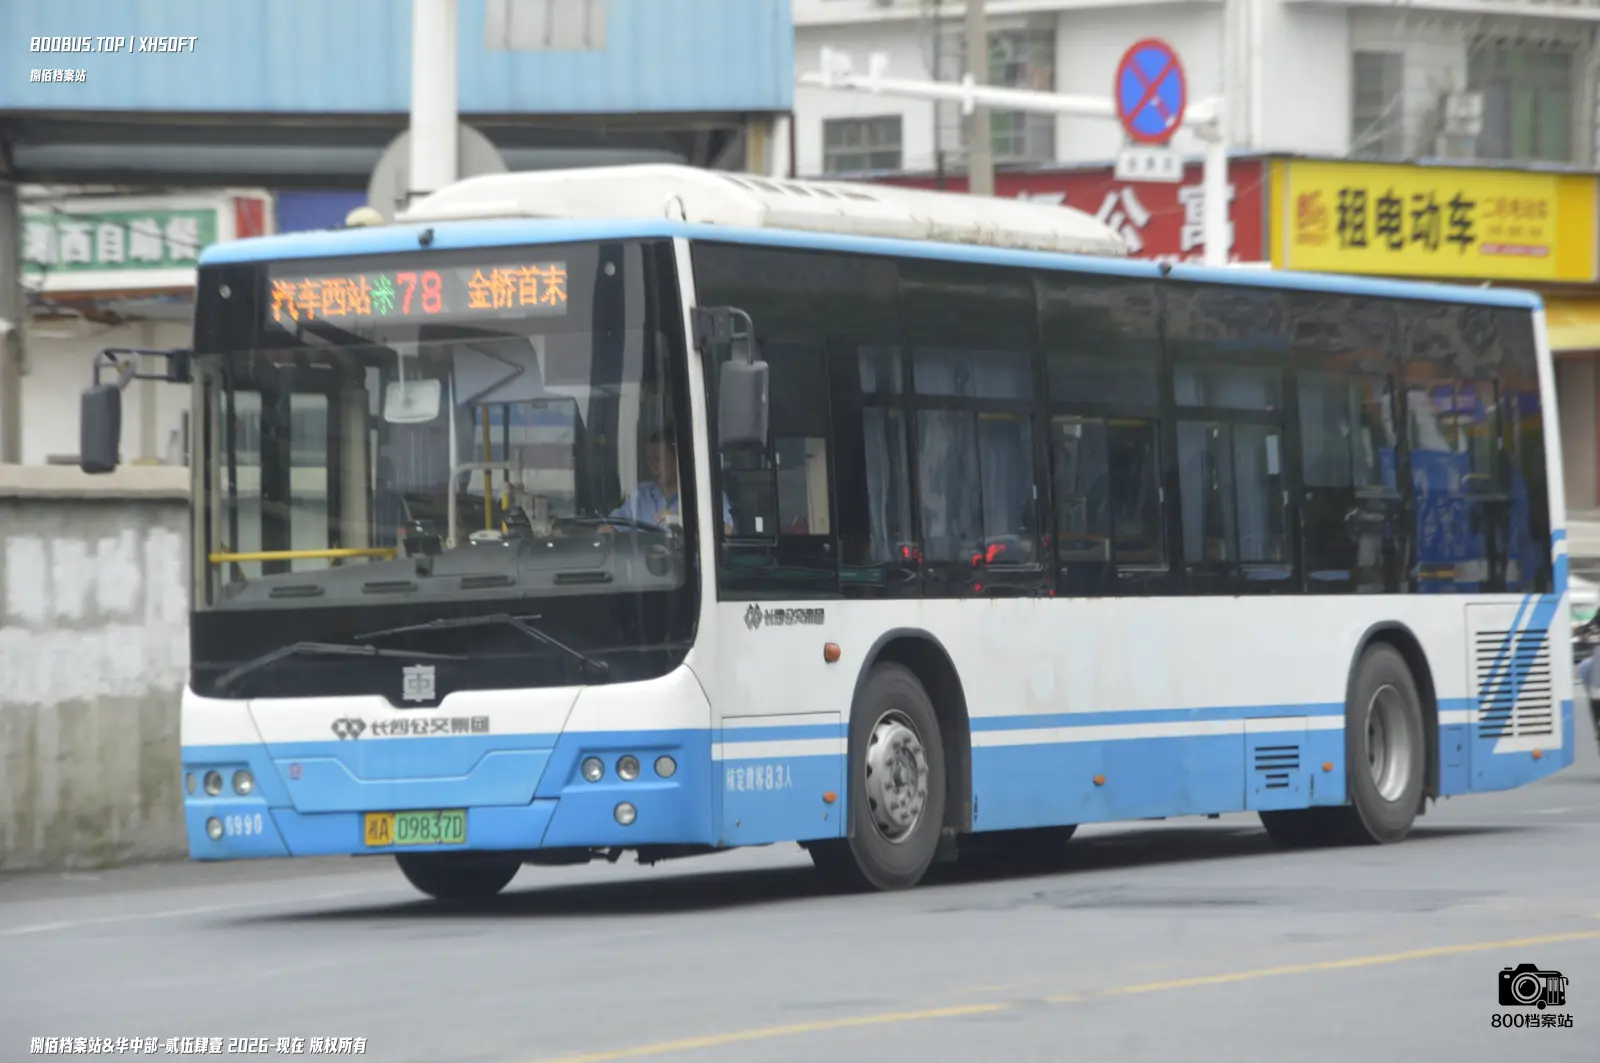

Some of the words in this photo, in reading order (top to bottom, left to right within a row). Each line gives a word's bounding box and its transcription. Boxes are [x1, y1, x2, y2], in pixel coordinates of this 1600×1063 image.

[1337, 186, 1477, 253] 租电动车
[270, 274, 371, 322] 汽车西站
[396, 270, 442, 313] 78
[371, 716, 490, 736] 长沙公交集团
